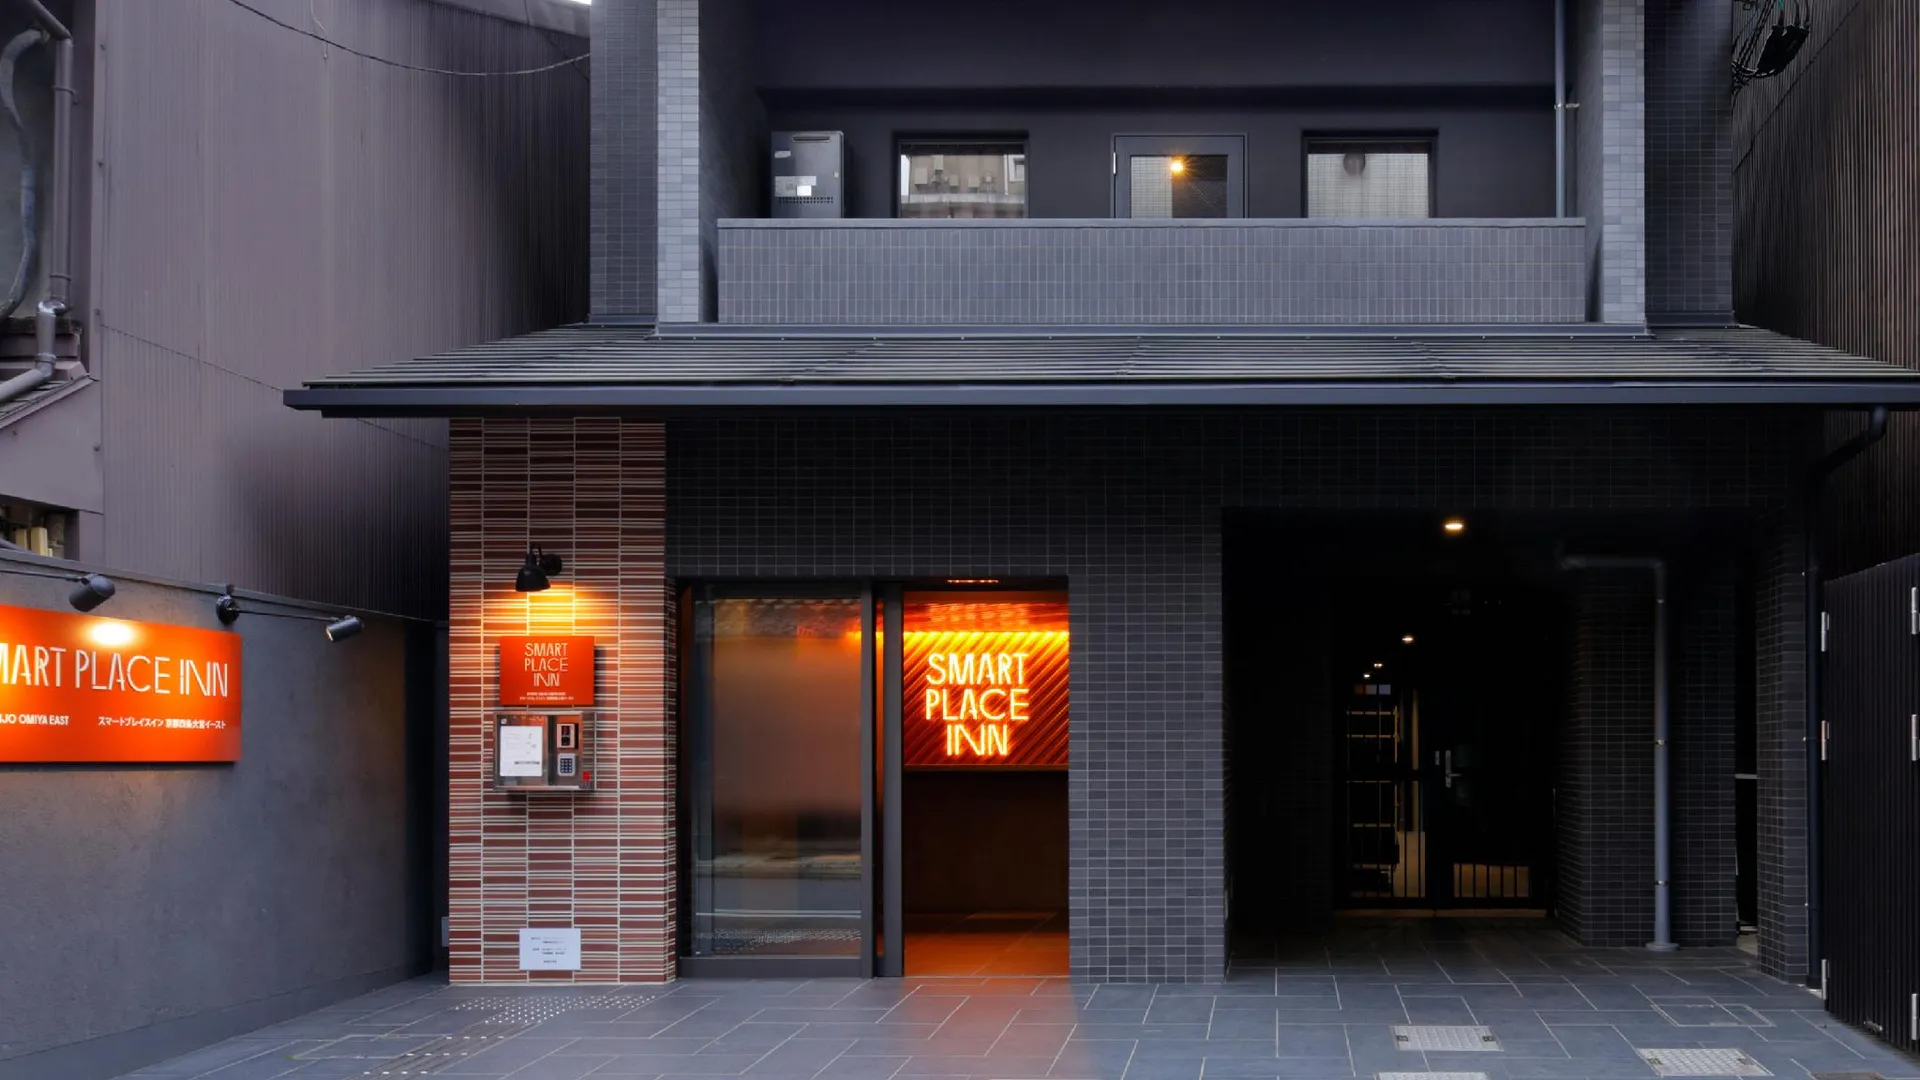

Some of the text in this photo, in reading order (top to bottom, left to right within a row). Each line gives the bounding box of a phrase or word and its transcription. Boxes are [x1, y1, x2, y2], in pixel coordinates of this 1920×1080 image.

[524, 643, 569, 657] SMART
[75, 649, 171, 694] PLACE
[179, 659, 228, 697] INN
[524, 657, 569, 672] PLACE
[925, 652, 1030, 685] SMART
[533, 672, 560, 687] INN
[925, 688, 1030, 721] PLACE
[19, 713, 48, 725] OMIYA
[49, 714, 70, 726] EAST
[946, 723, 1009, 756] INN
